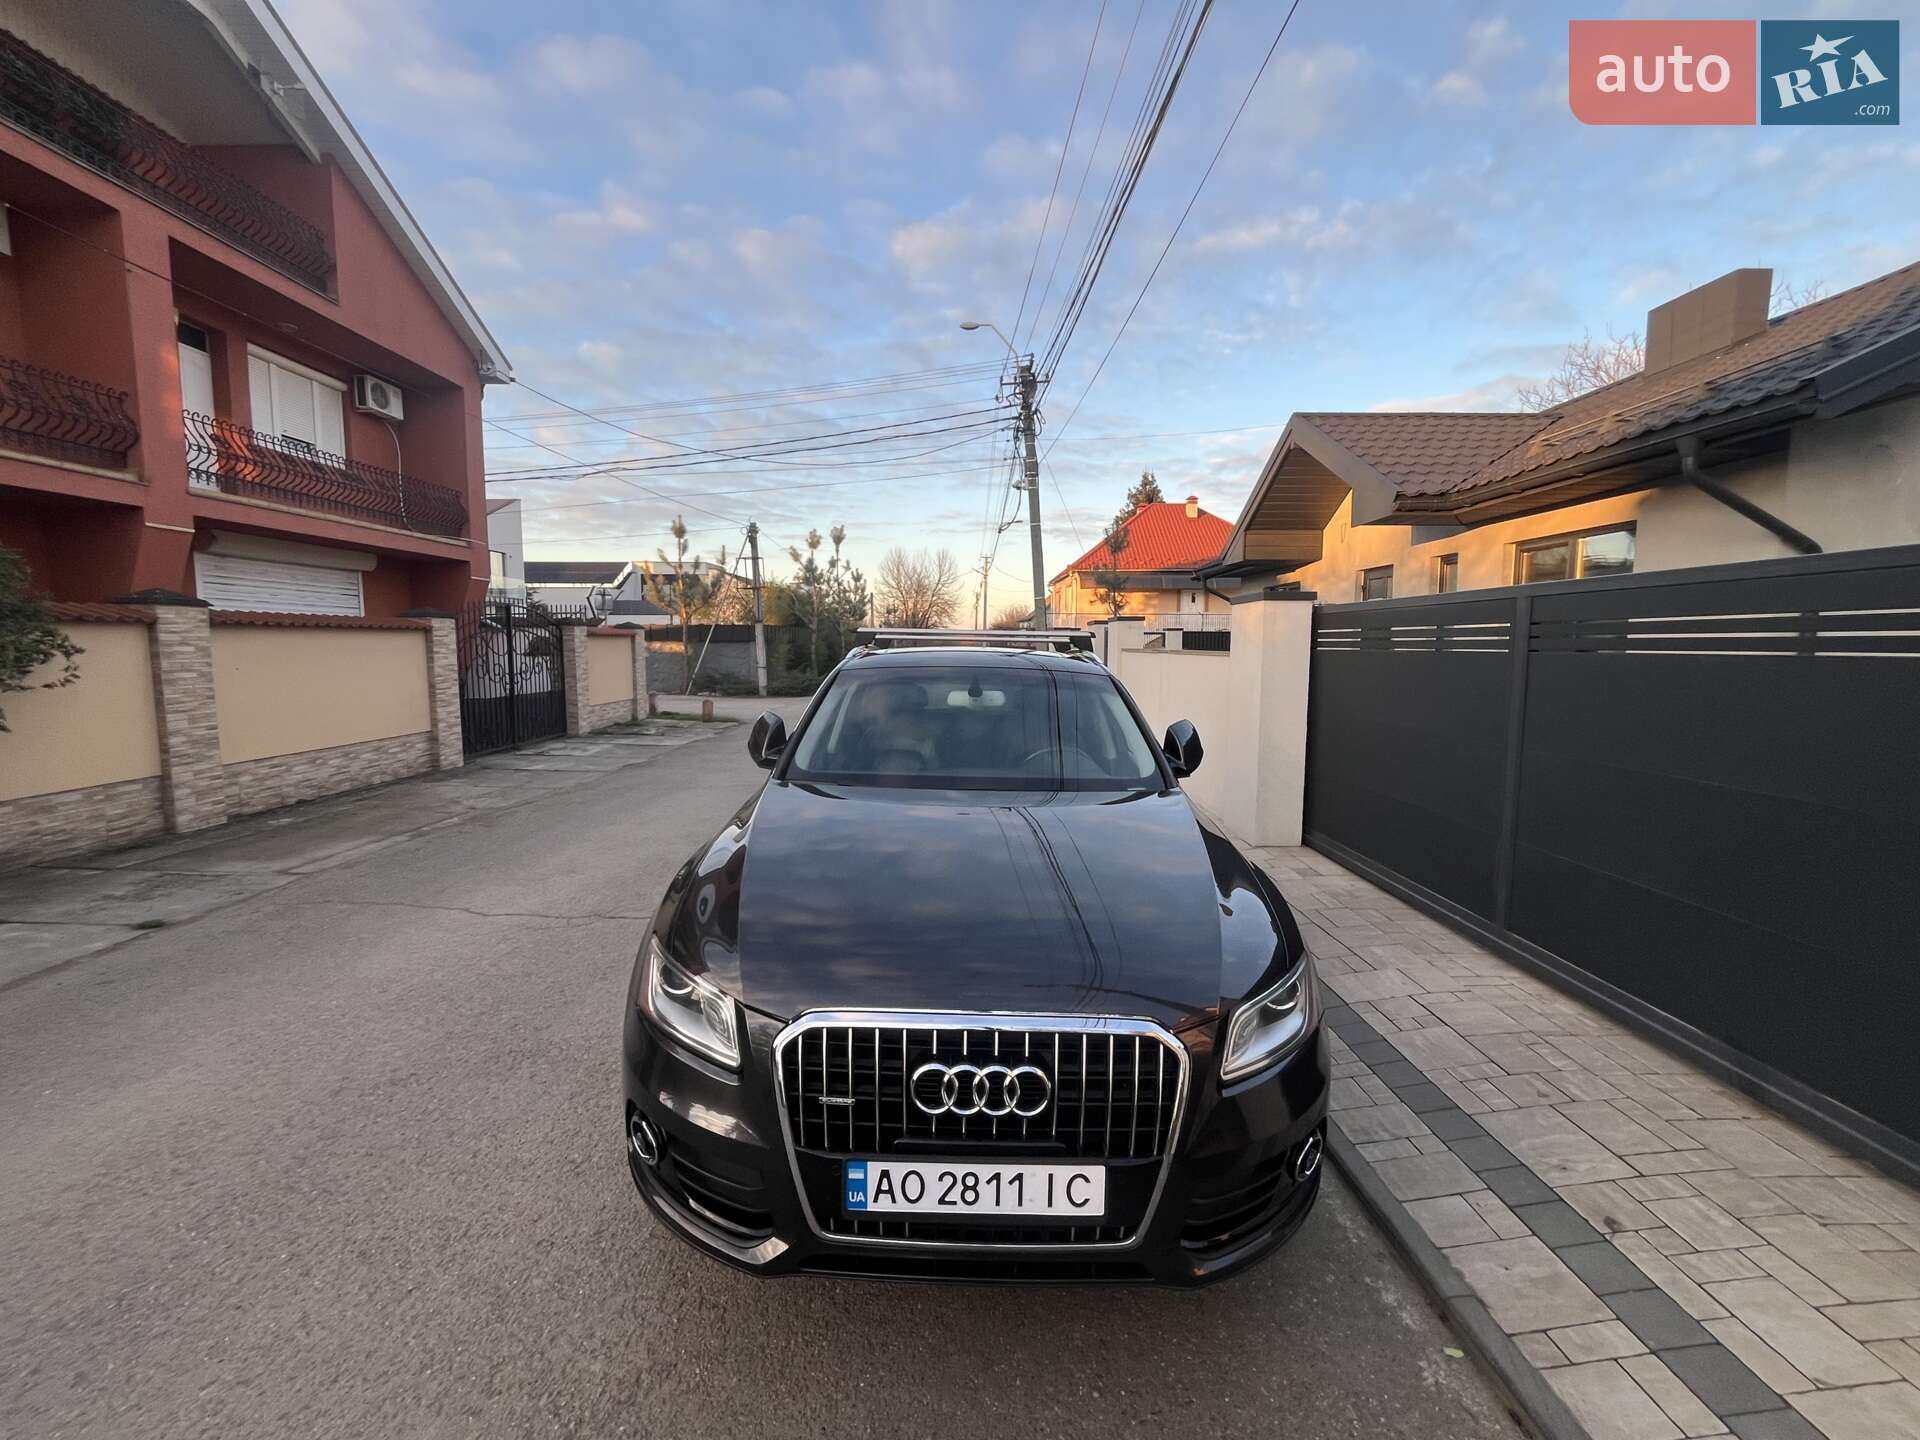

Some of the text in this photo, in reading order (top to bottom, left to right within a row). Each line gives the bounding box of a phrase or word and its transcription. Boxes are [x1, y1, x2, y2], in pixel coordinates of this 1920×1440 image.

[848, 1191, 865, 1203] UA
[872, 1169, 1091, 1208] AO 2811 IC
